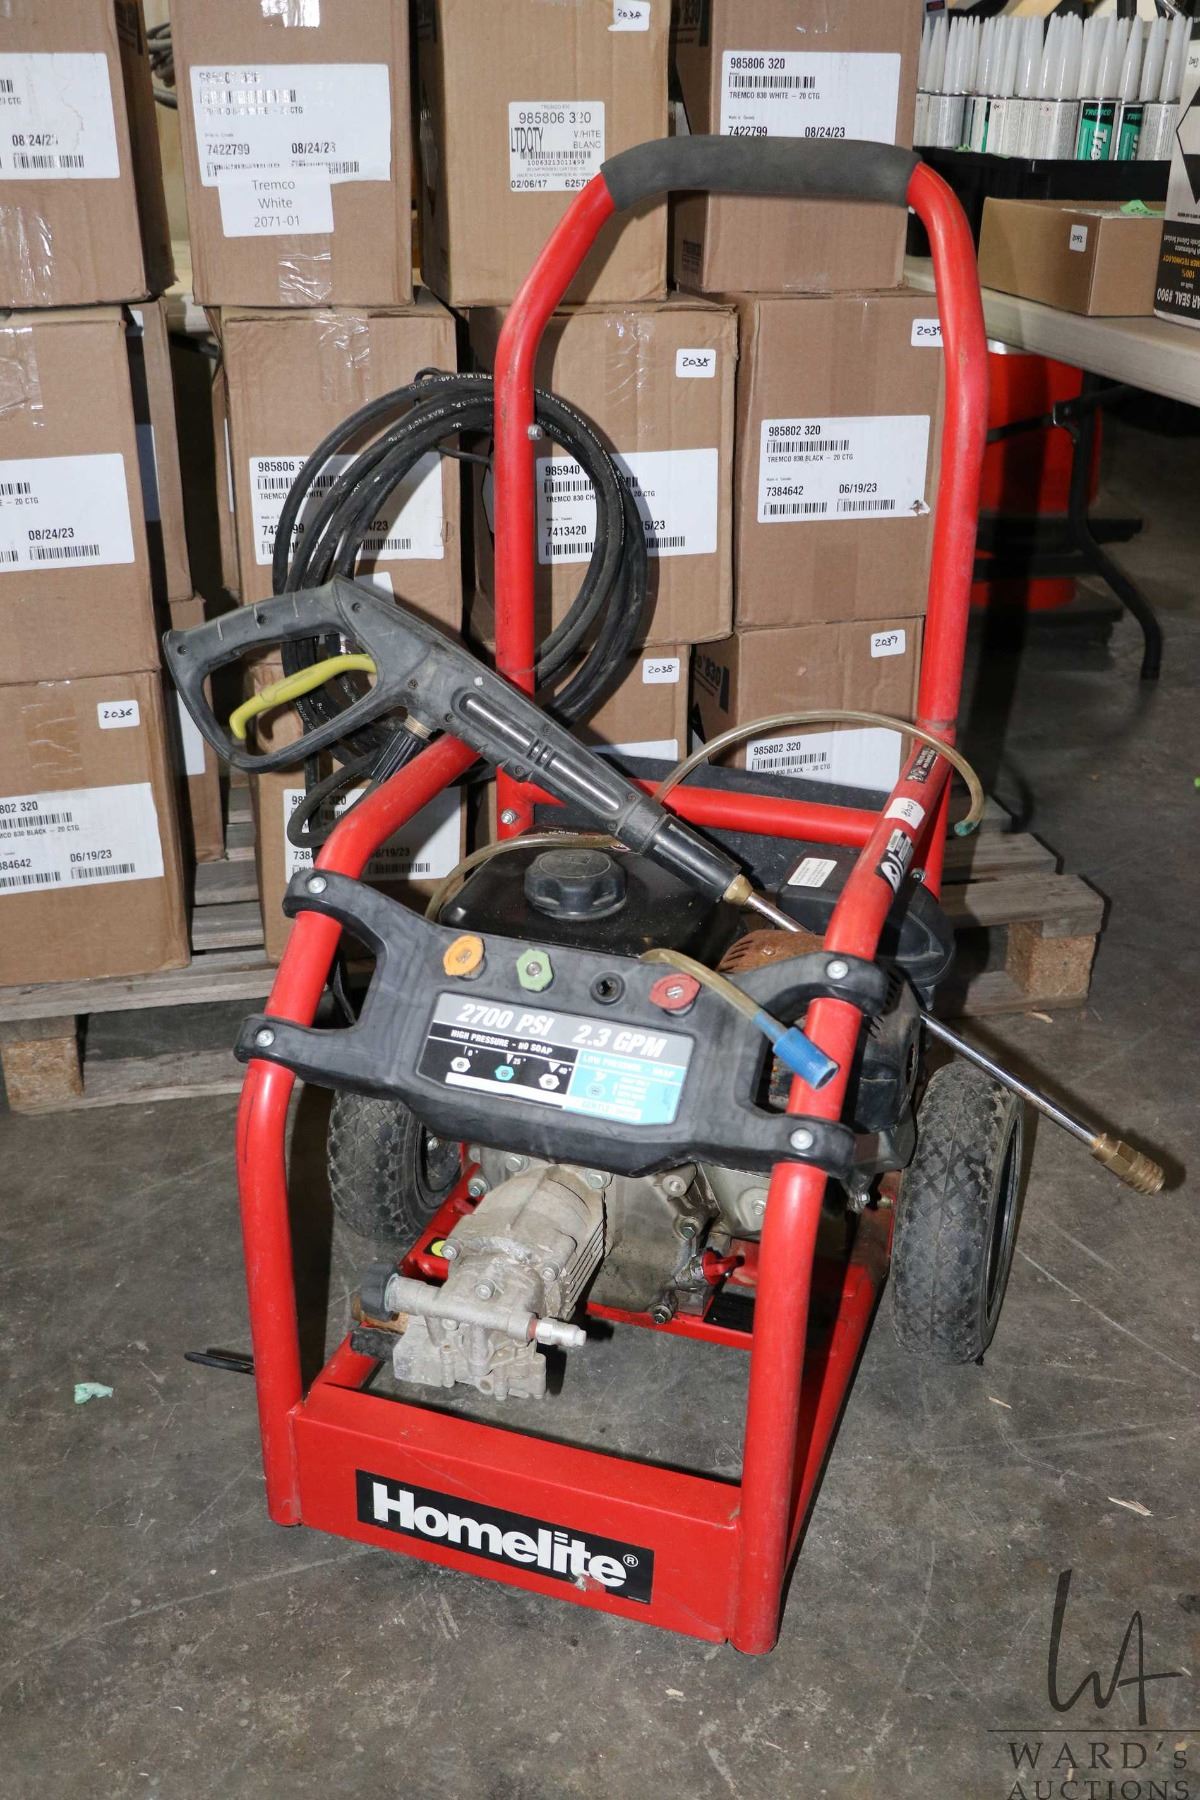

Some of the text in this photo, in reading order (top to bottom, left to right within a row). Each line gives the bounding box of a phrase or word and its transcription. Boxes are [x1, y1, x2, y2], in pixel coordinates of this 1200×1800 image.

[730, 58, 786, 70] 985806 320
[519, 112, 591, 124] 985806 320
[573, 130, 601, 138] WHITE
[728, 126, 845, 138] 7422799 08/24/23
[207, 142, 336, 156] 7422799 08/24/23
[573, 140, 601, 149] BLANC
[251, 179, 296, 190] Tremco
[511, 180, 548, 188] 02/06/17
[258, 197, 293, 209] White
[254, 215, 300, 228] 2071-01
[1162, 255, 1190, 266] TECHNOLOGY
[1156, 288, 1174, 303] #900
[1175, 291, 1190, 308] SEAL
[768, 425, 820, 436] 985802 320
[768, 455, 792, 463] TREMCO
[804, 454, 824, 462] BLACK
[258, 461, 295, 472] 985806
[545, 464, 580, 476] 985940
[766, 483, 878, 496] 7384642 06/19/23
[25, 497, 38, 505] CTG
[546, 494, 571, 503] TREMCO
[28, 528, 75, 540] 08/24/23
[547, 526, 587, 537] 7413420
[104, 708, 133, 719] 2036
[754, 742, 801, 756] 985802 320
[20, 801, 38, 812] 320
[70, 850, 112, 863] 06/19/23
[456, 1004, 668, 1058] 2700 PSI 2.3 GPM
[450, 1030, 469, 1040] HIGH
[471, 1034, 509, 1047] PRESSURE
[518, 1042, 529, 1050] NO
[530, 1044, 552, 1054] SOAP
